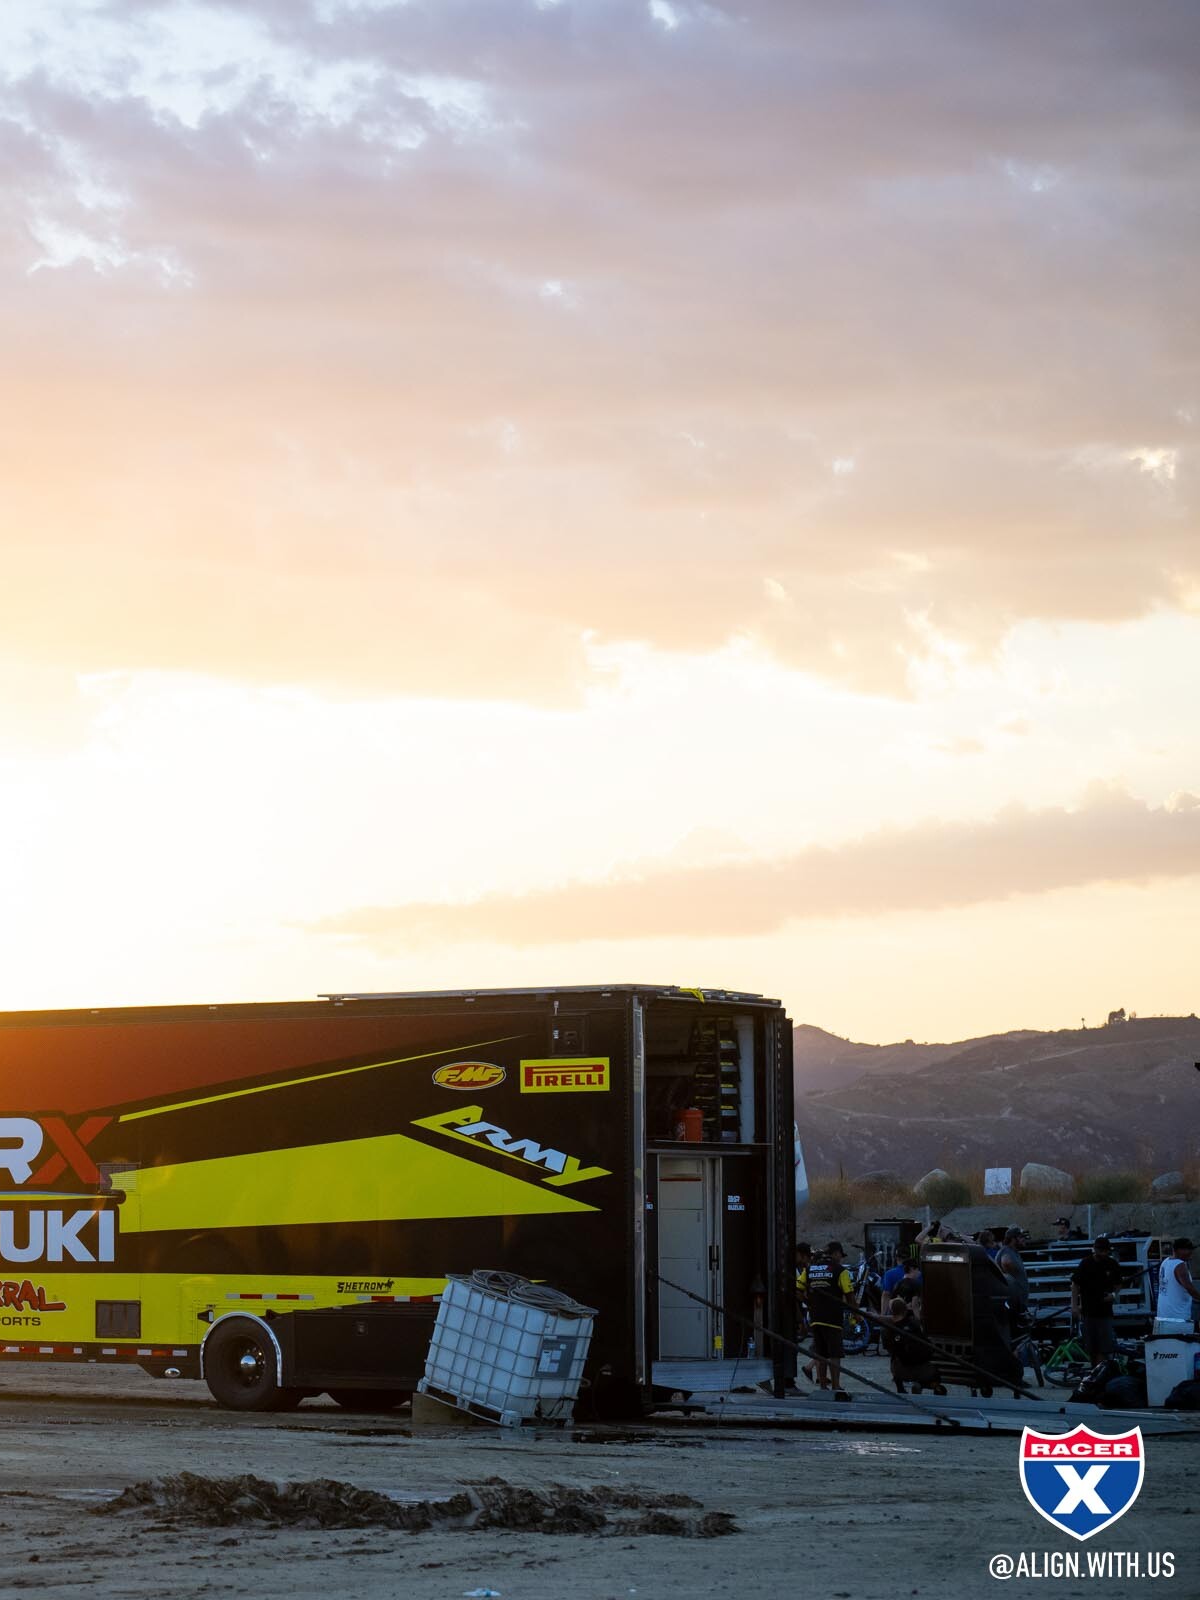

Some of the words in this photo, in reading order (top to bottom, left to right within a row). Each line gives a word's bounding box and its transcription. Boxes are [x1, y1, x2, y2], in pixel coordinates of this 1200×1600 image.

[435, 1066, 504, 1083] FMF
[524, 1064, 605, 1087] PIRELLI
[337, 1281, 384, 1294] SHETRON
